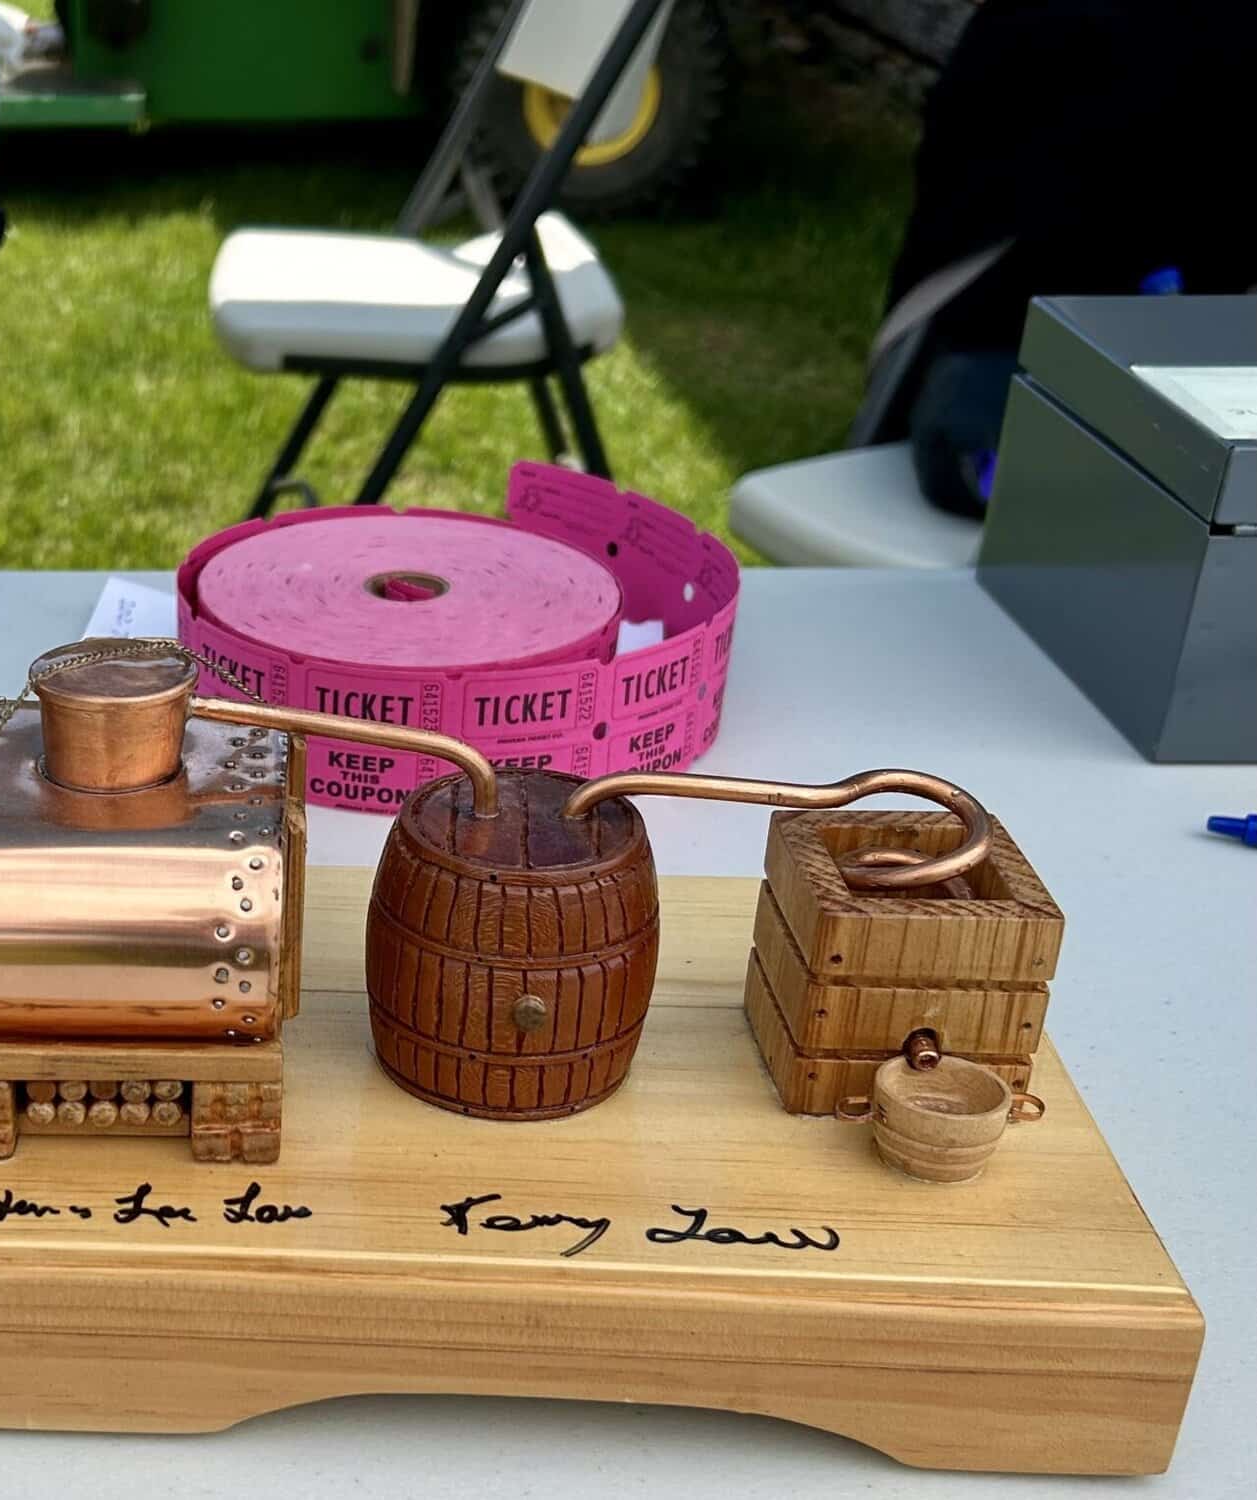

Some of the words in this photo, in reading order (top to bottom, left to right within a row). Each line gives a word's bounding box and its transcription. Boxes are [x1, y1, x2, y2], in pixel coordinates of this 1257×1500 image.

[622, 655, 690, 706] TICKET
[314, 685, 415, 727] TICKET
[474, 688, 573, 727] TICKET
[628, 722, 676, 753] KEEP
[327, 750, 396, 774] KEEP
[339, 770, 381, 785] THIS
[309, 777, 413, 805] COUPON
